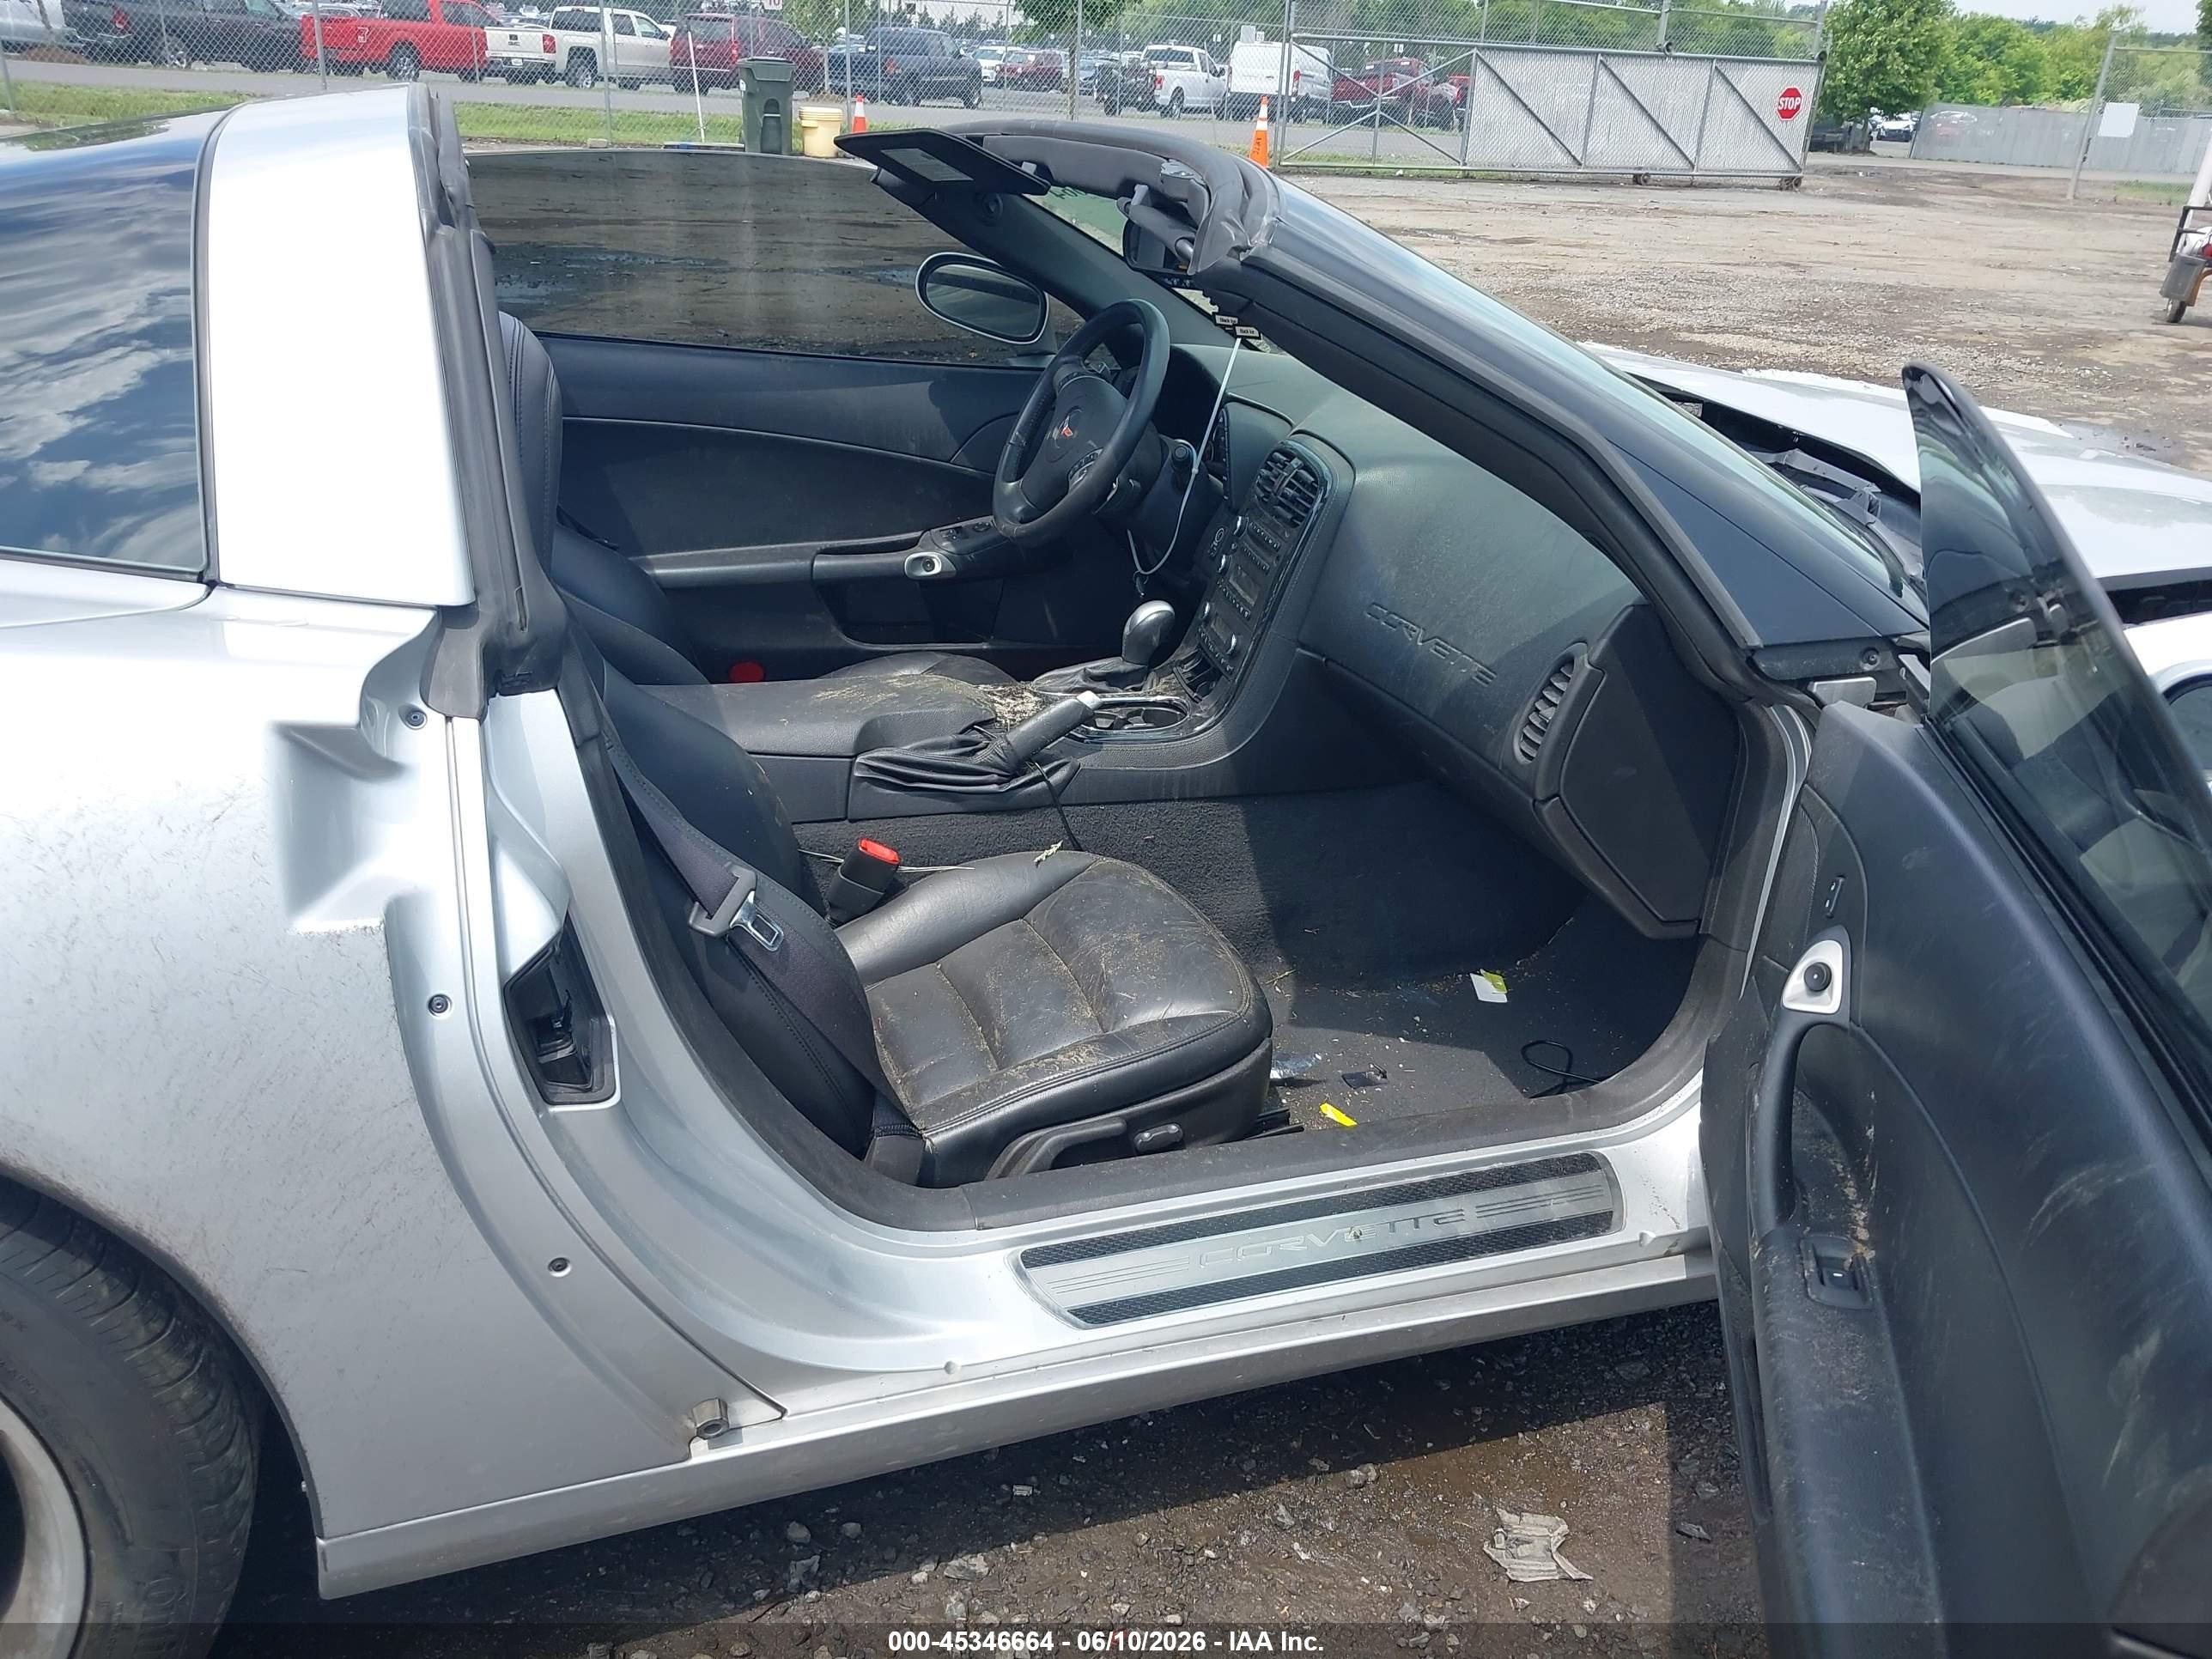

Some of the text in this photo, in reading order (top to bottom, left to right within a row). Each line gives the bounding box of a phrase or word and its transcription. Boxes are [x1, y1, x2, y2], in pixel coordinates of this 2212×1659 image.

[1778, 97, 1802, 110] STOP
[1364, 602, 1497, 687] CORVETTE
[1200, 1208, 1465, 1267] CORVETTE
